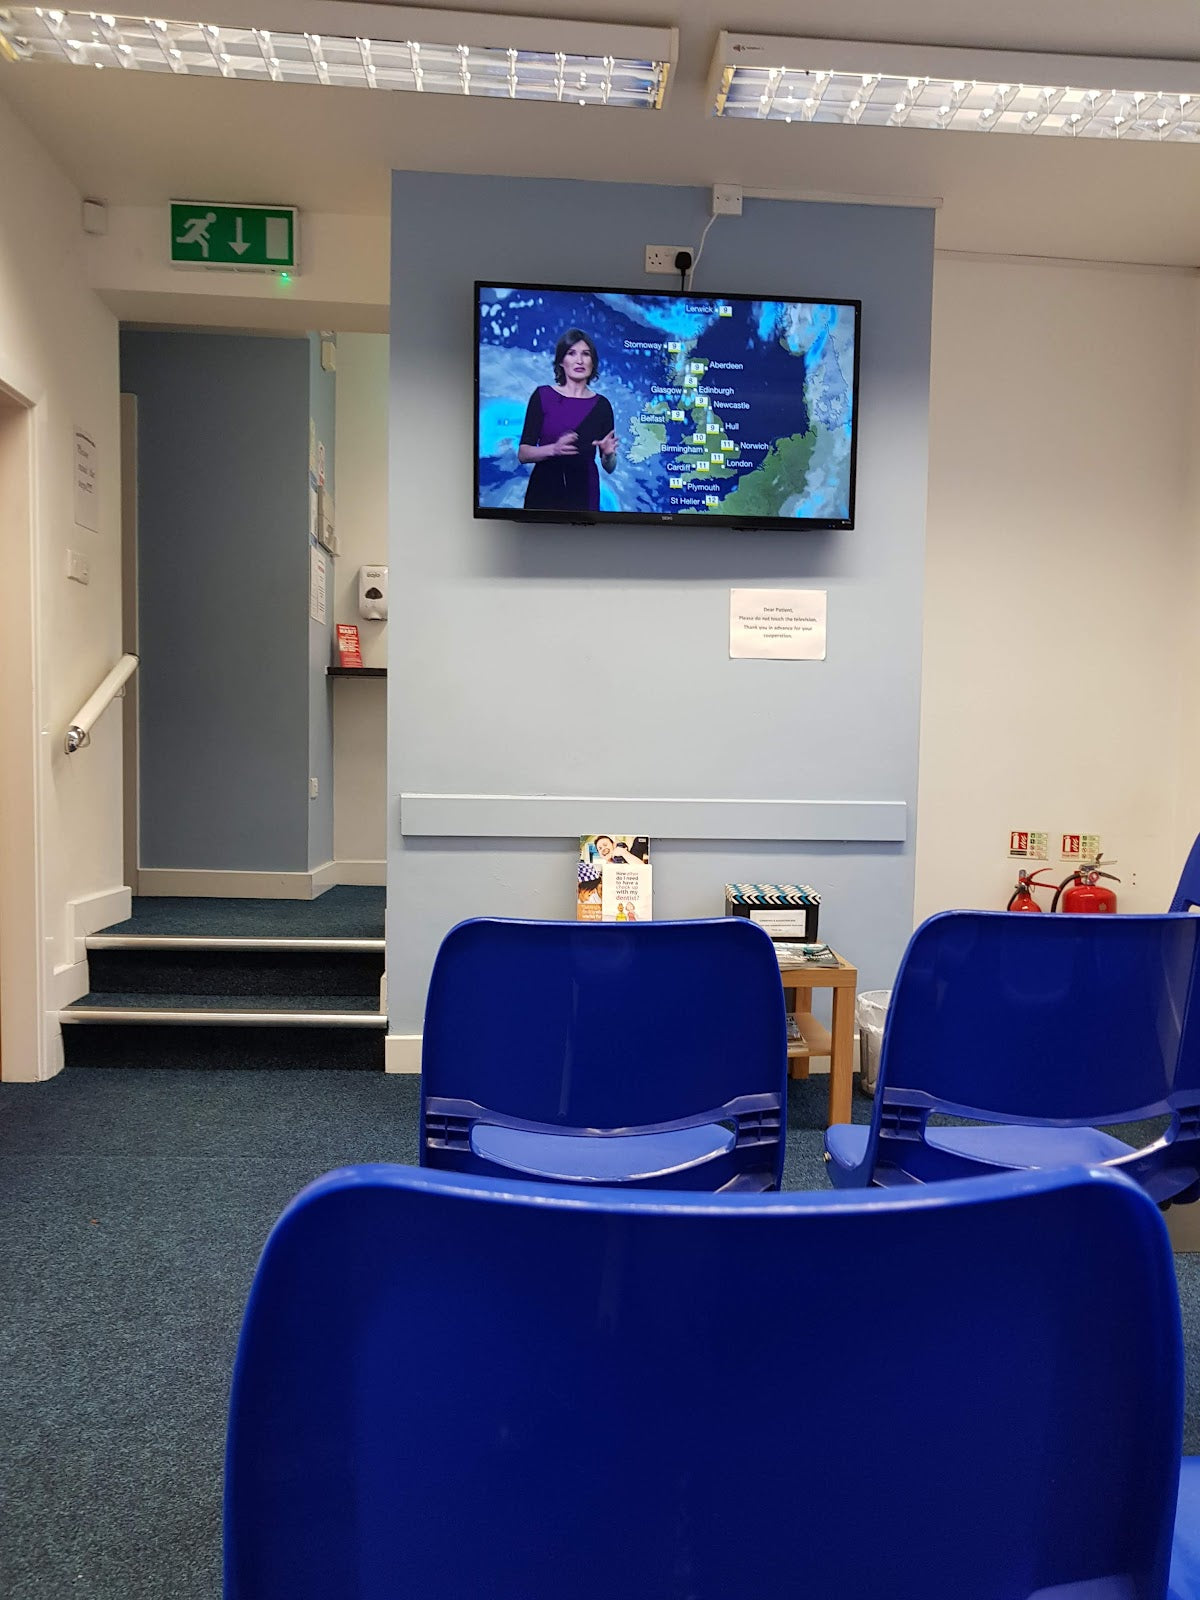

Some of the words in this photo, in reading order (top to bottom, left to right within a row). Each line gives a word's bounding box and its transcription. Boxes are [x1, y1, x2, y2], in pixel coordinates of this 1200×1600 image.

[686, 305, 713, 313] Lerwick
[624, 340, 662, 350] Stornoway
[709, 361, 743, 370] Aberdeen
[651, 386, 682, 395] Glasgow
[698, 386, 734, 396] Edinburgh
[713, 401, 750, 410] Newcastle
[640, 414, 665, 423] Belfast
[725, 422, 740, 431] Hull
[661, 444, 703, 454] Birmingham
[740, 441, 769, 450] Norwich
[667, 463, 691, 472] Cardiff
[726, 460, 753, 468] London
[687, 483, 720, 493] Plymouth
